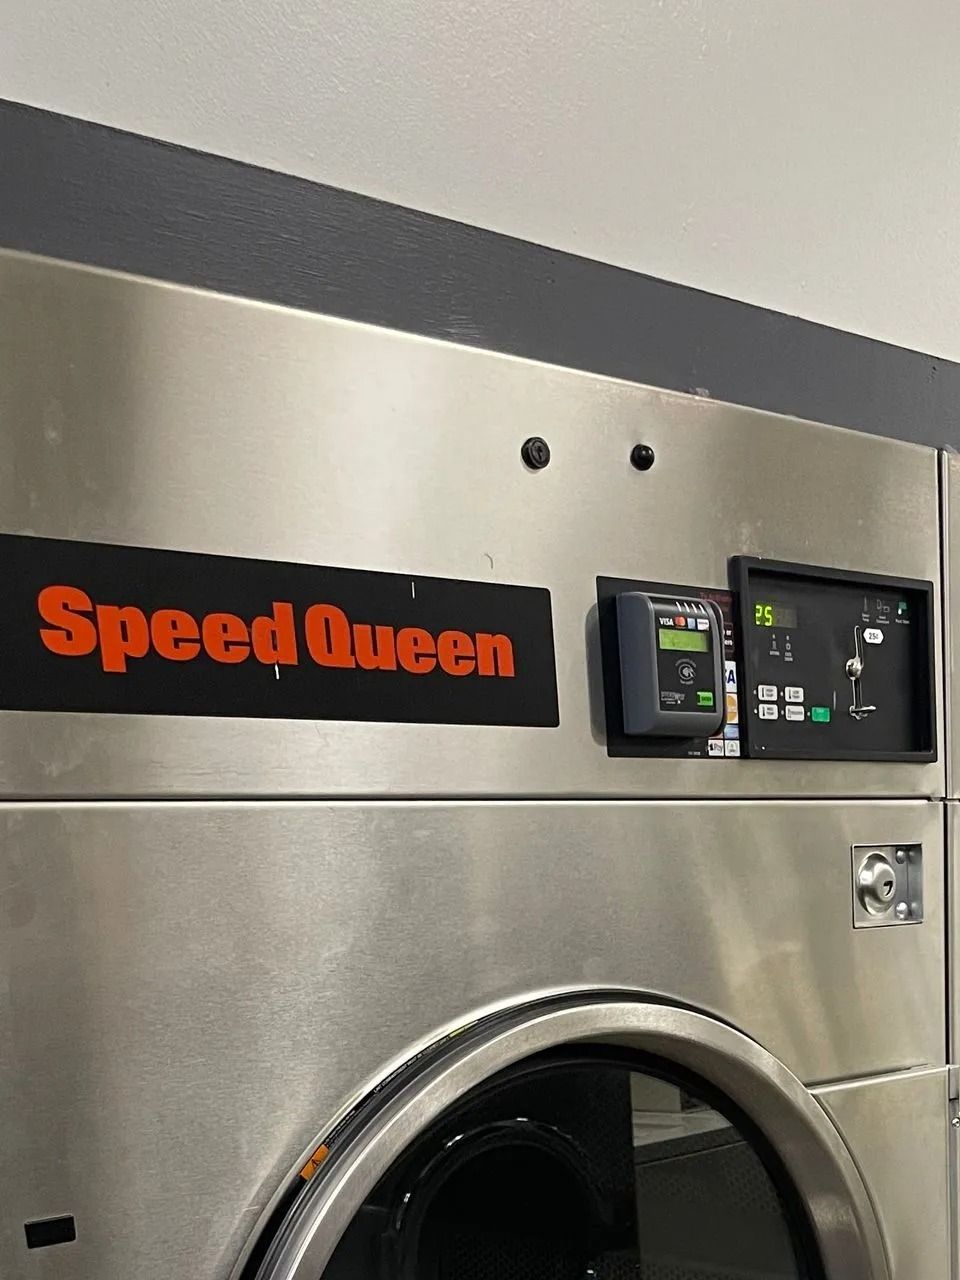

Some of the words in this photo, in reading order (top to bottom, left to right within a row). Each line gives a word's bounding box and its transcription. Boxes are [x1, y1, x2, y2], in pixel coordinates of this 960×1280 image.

[659, 617, 674, 626] VISA
[755, 605, 773, 627] 25
[37, 585, 298, 673] Speed
[304, 603, 515, 677] Queen
